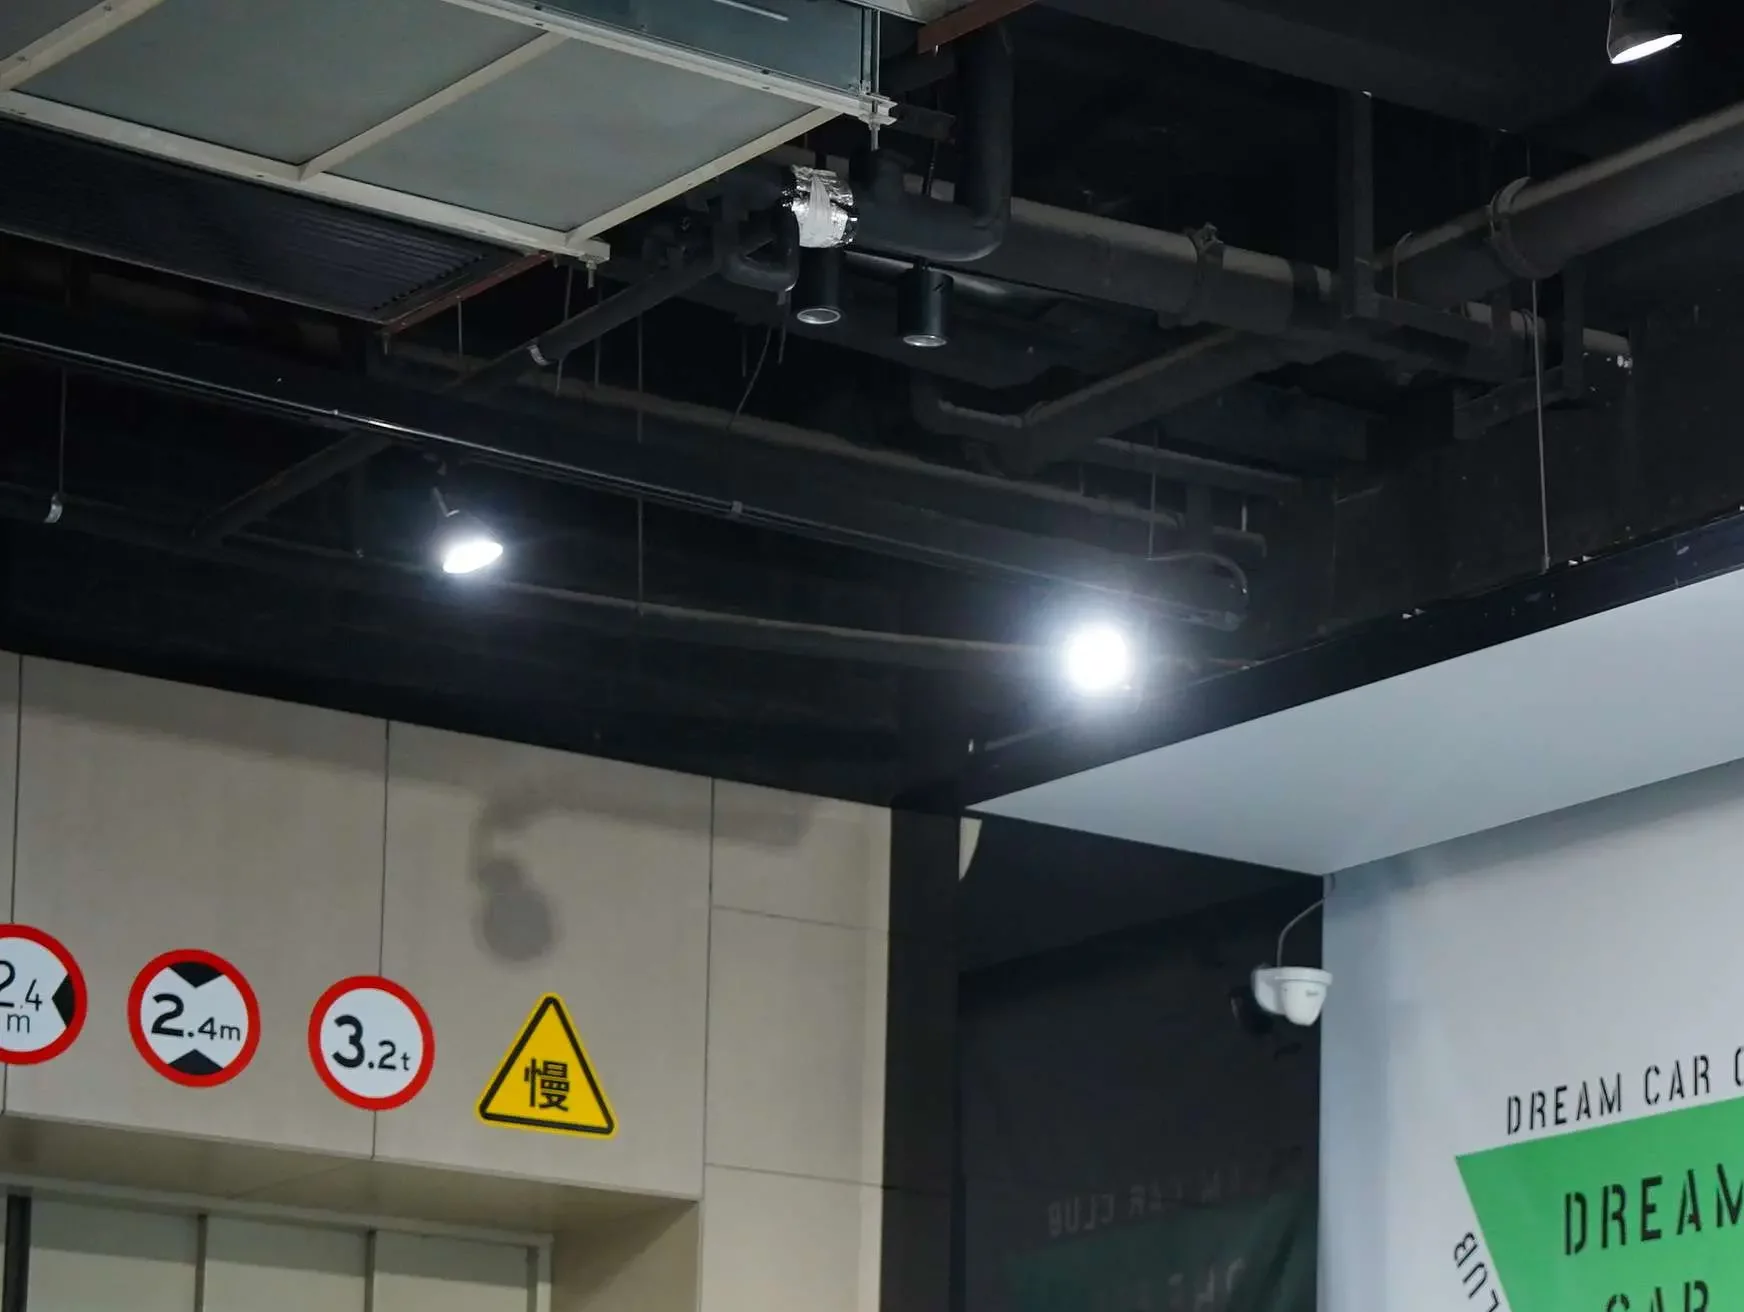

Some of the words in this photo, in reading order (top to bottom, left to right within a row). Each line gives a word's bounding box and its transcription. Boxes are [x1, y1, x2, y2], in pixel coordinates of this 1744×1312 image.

[7, 1013, 31, 1033] m
[151, 993, 241, 1042] 2.4m
[332, 1014, 410, 1071] 3.2t
[524, 1059, 570, 1112] 慢
[1506, 1073, 1623, 1136] DREAM
[1644, 1054, 1710, 1104] CAR
